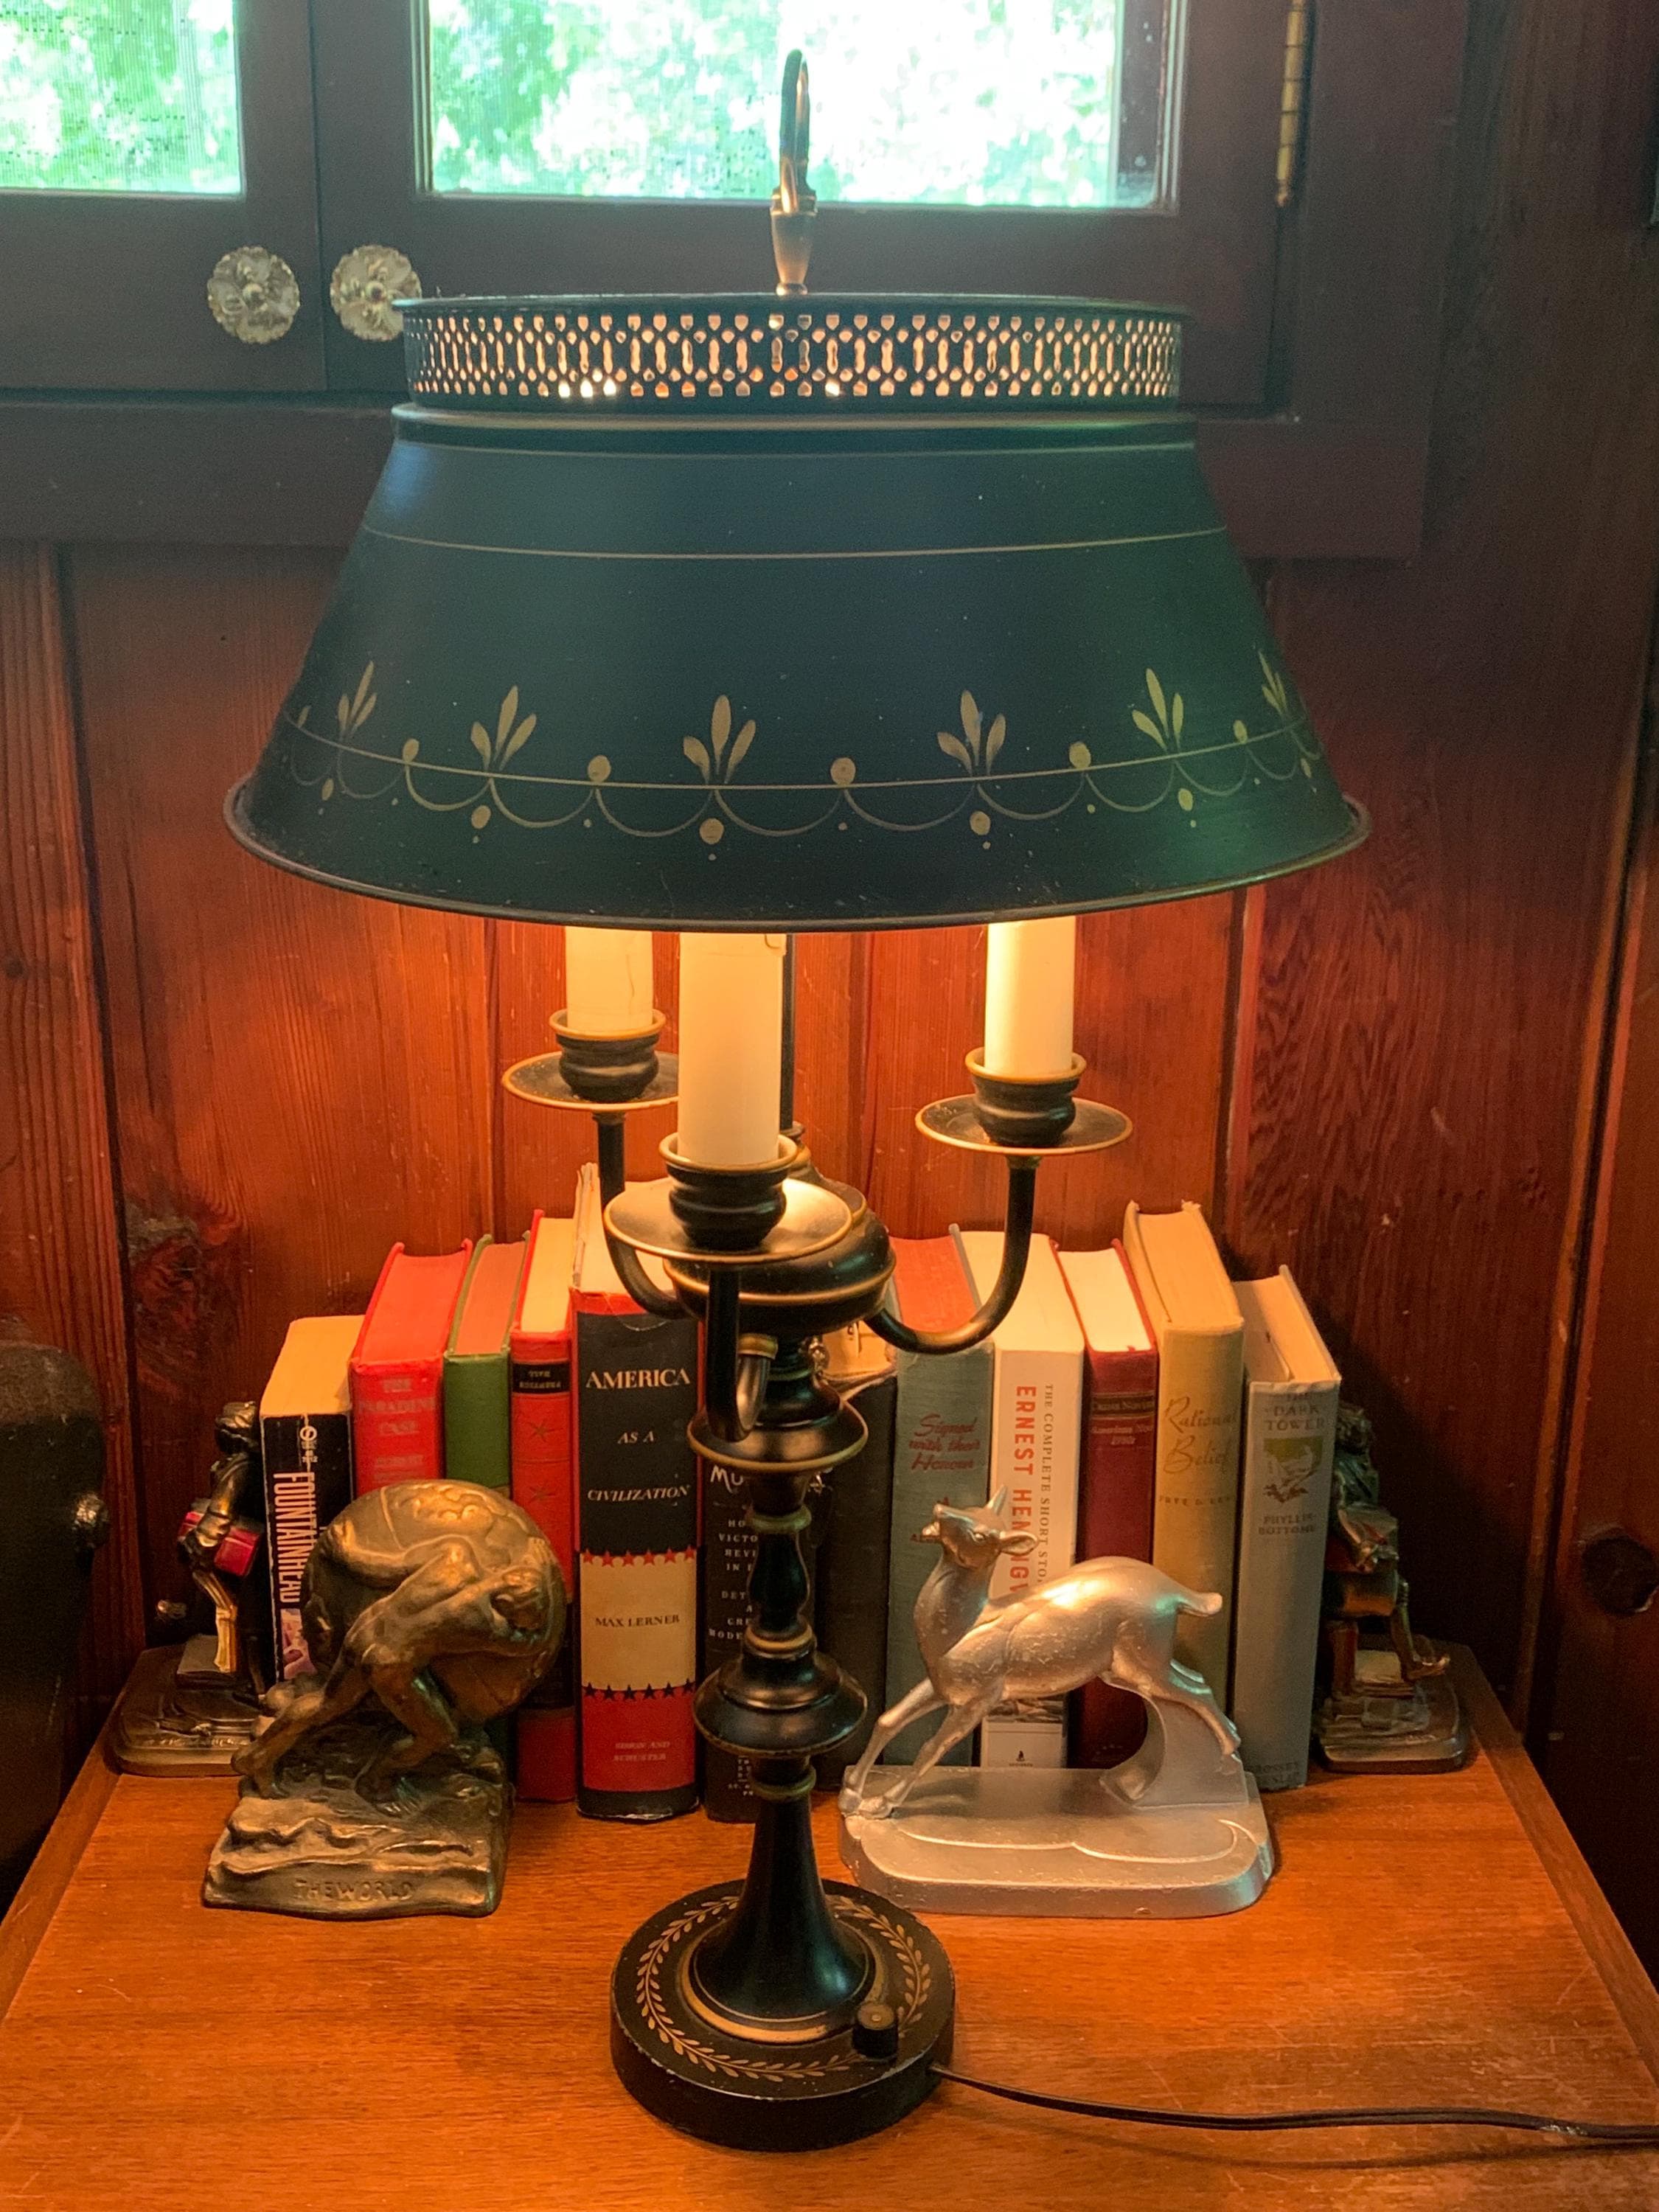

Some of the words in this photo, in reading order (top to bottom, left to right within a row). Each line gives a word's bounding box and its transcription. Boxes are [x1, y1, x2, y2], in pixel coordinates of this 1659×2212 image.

[585, 1368, 691, 1389] AMERICA
[1044, 1384, 1054, 1408] THE
[617, 1431, 639, 1444] AS
[643, 1430, 655, 1443] A
[1014, 1386, 1037, 1475] ERNEST
[1041, 1413, 1054, 1492] COMPLETE
[587, 1484, 691, 1502] CIVILIZATION
[1038, 1498, 1051, 1546] SHORT
[718, 1534, 759, 1543] VICTO
[721, 1590, 746, 1599] DET
[595, 1617, 625, 1627] MAX
[627, 1614, 680, 1627] LERNER
